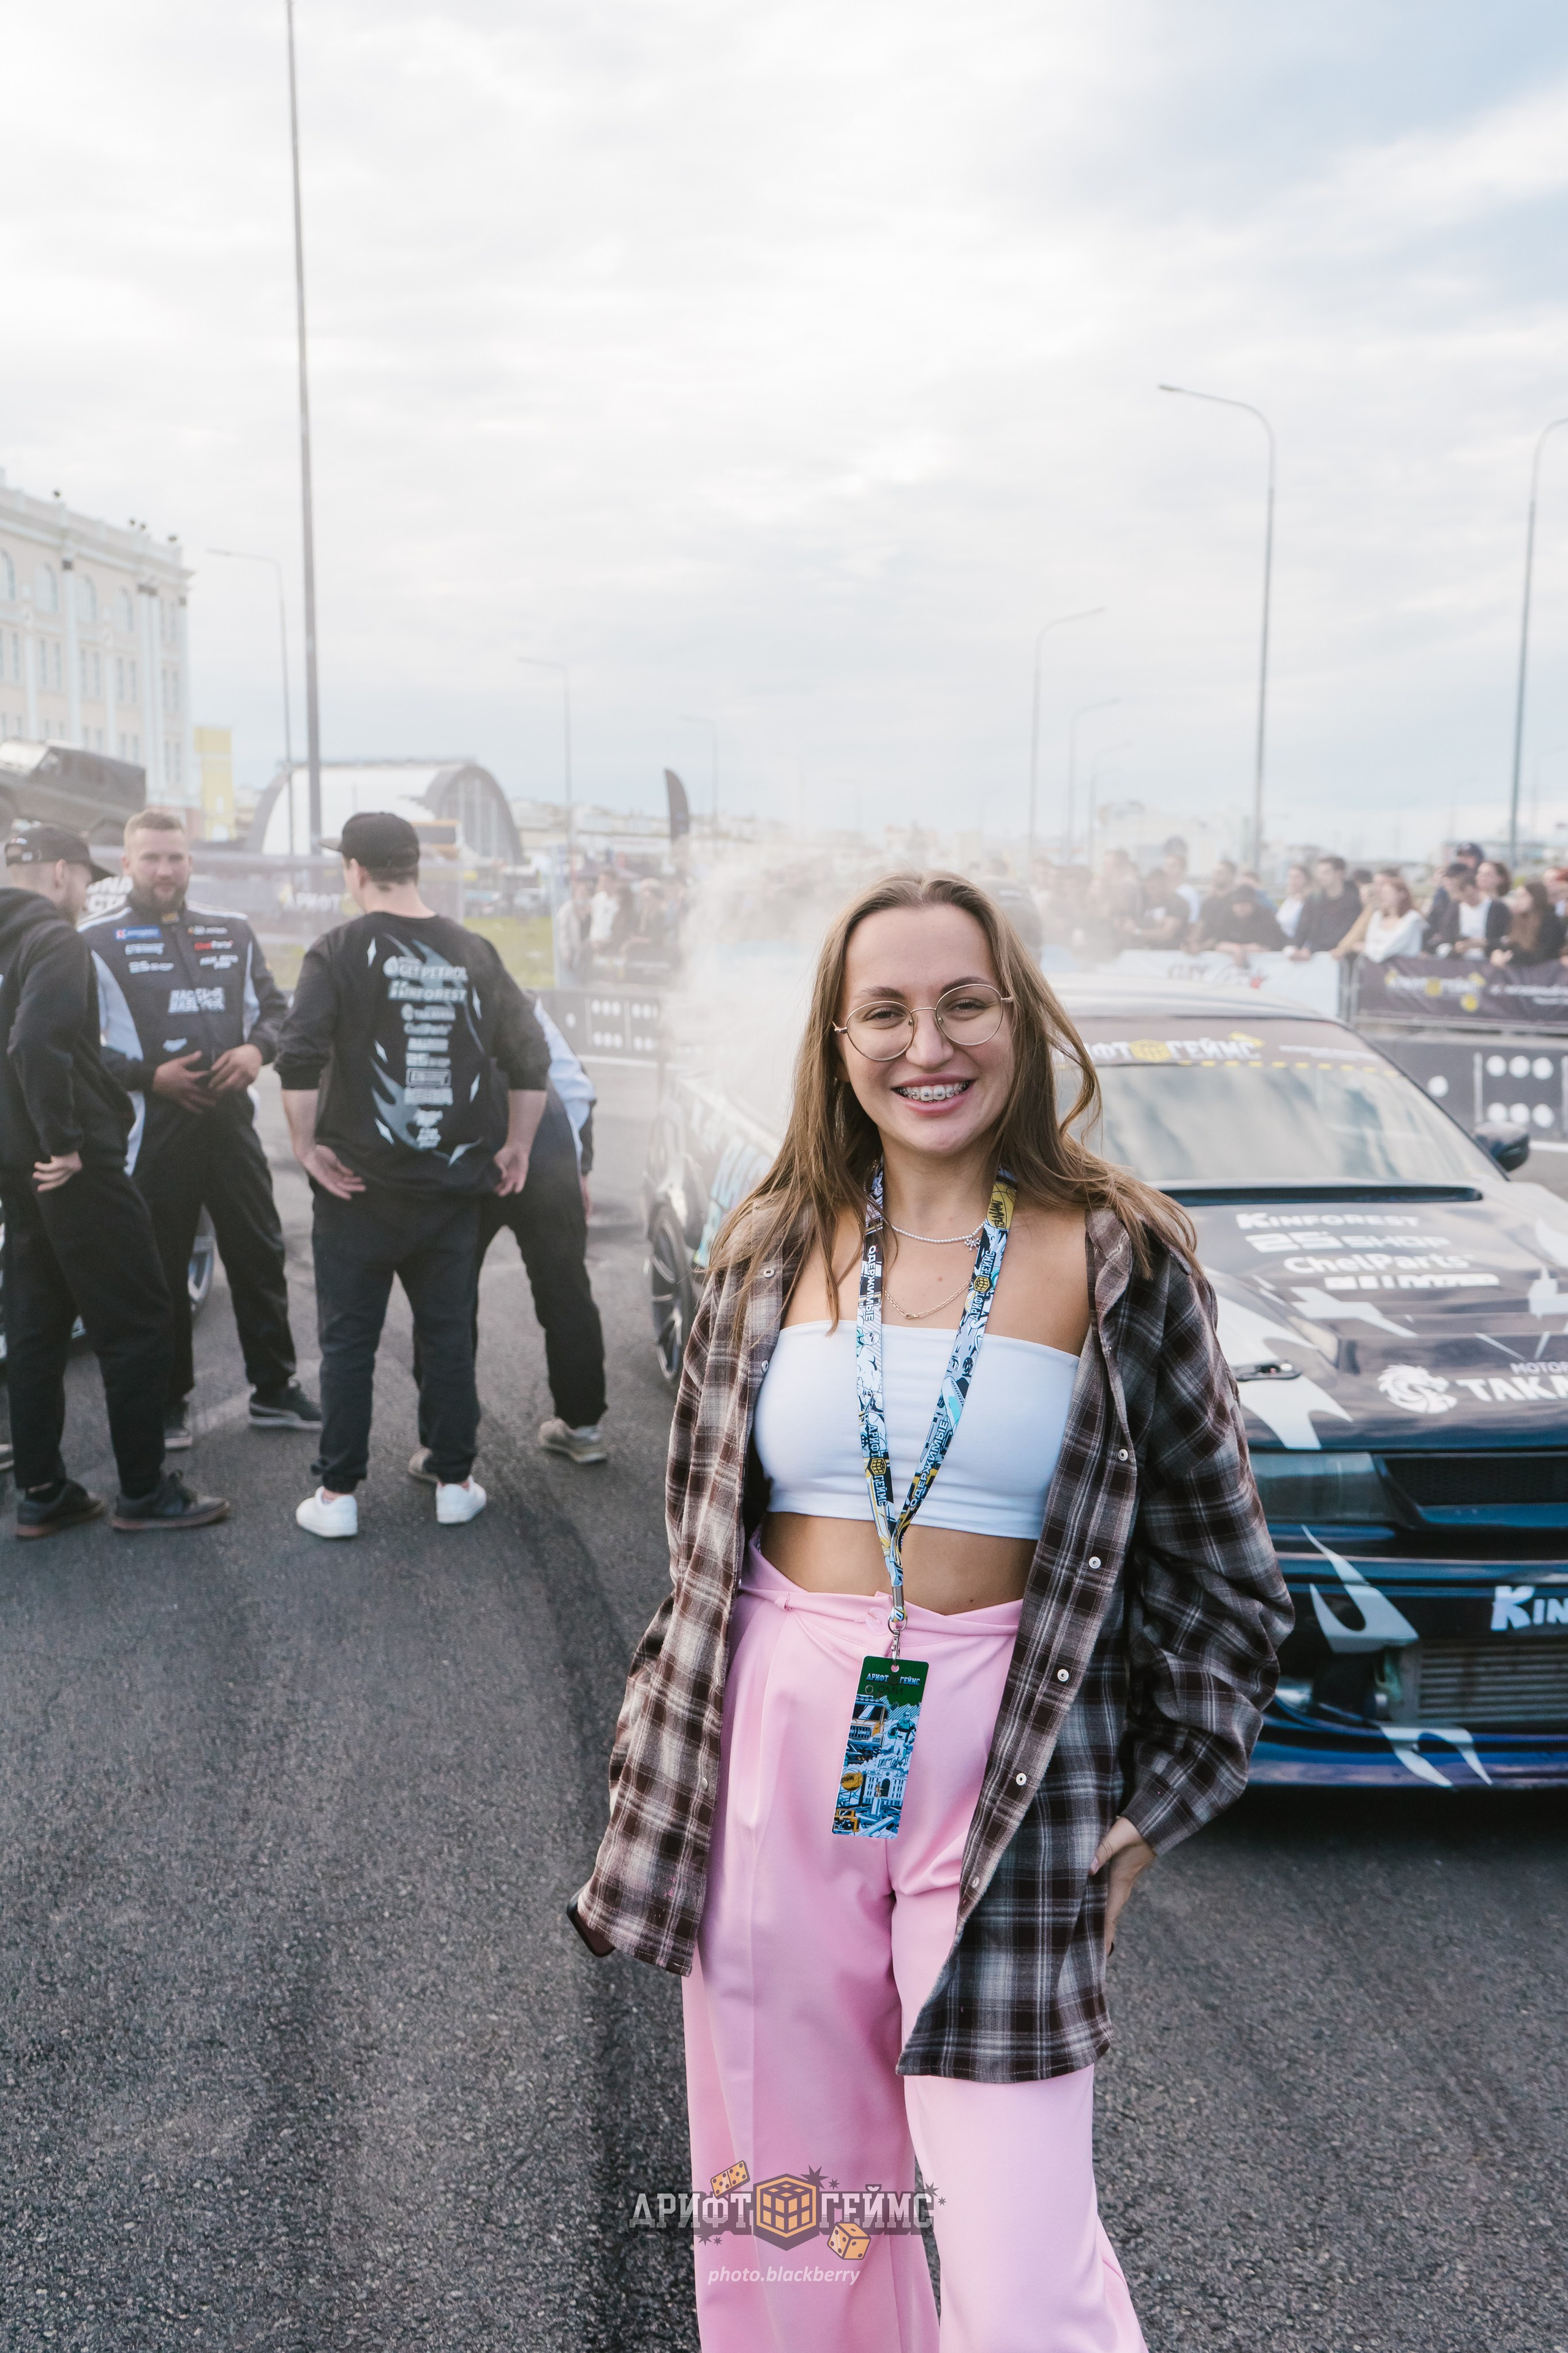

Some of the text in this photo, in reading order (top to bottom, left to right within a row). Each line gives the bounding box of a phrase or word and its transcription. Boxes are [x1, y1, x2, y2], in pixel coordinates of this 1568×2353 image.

[1165, 1038, 1262, 1060] ГЕЙМС
[1236, 1212, 1419, 1229] KINFOREST
[865, 1245, 877, 1322] ОДЕРЖИМЫЕ
[970, 1250, 996, 1321] ДРИФТ ГЕЙМС
[1284, 1253, 1470, 1275] ChelParts
[868, 1424, 888, 1506] ДРИФТ ГЕЙМС
[910, 1419, 949, 1508] ОДЕРЖИМЫЕ
[866, 1673, 921, 1685] ДРИФТ ГЕЙМС
